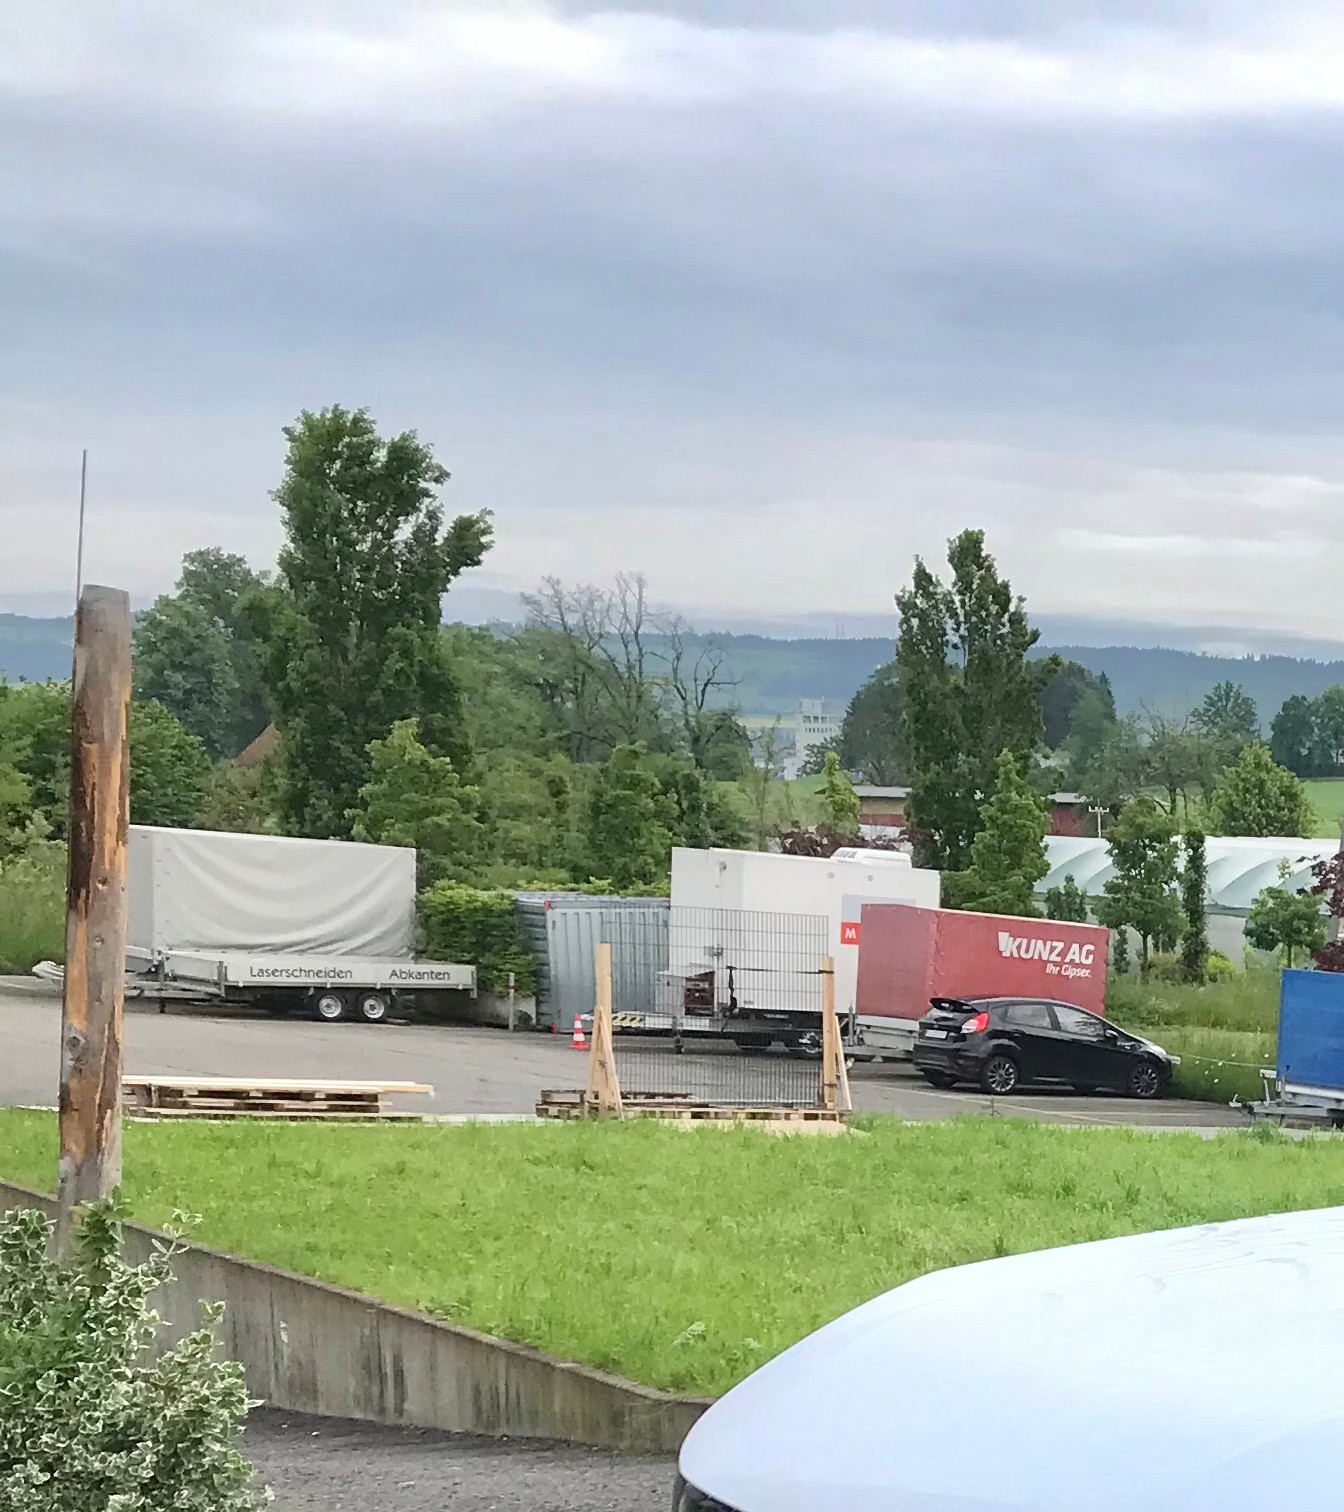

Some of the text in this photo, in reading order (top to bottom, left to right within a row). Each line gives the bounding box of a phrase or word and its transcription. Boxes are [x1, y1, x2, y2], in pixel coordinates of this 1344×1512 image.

[1001, 936, 1095, 965] KUNZ AG
[249, 966, 450, 981] Laserschneiden Abkanten
[1046, 963, 1060, 975] Ihr
